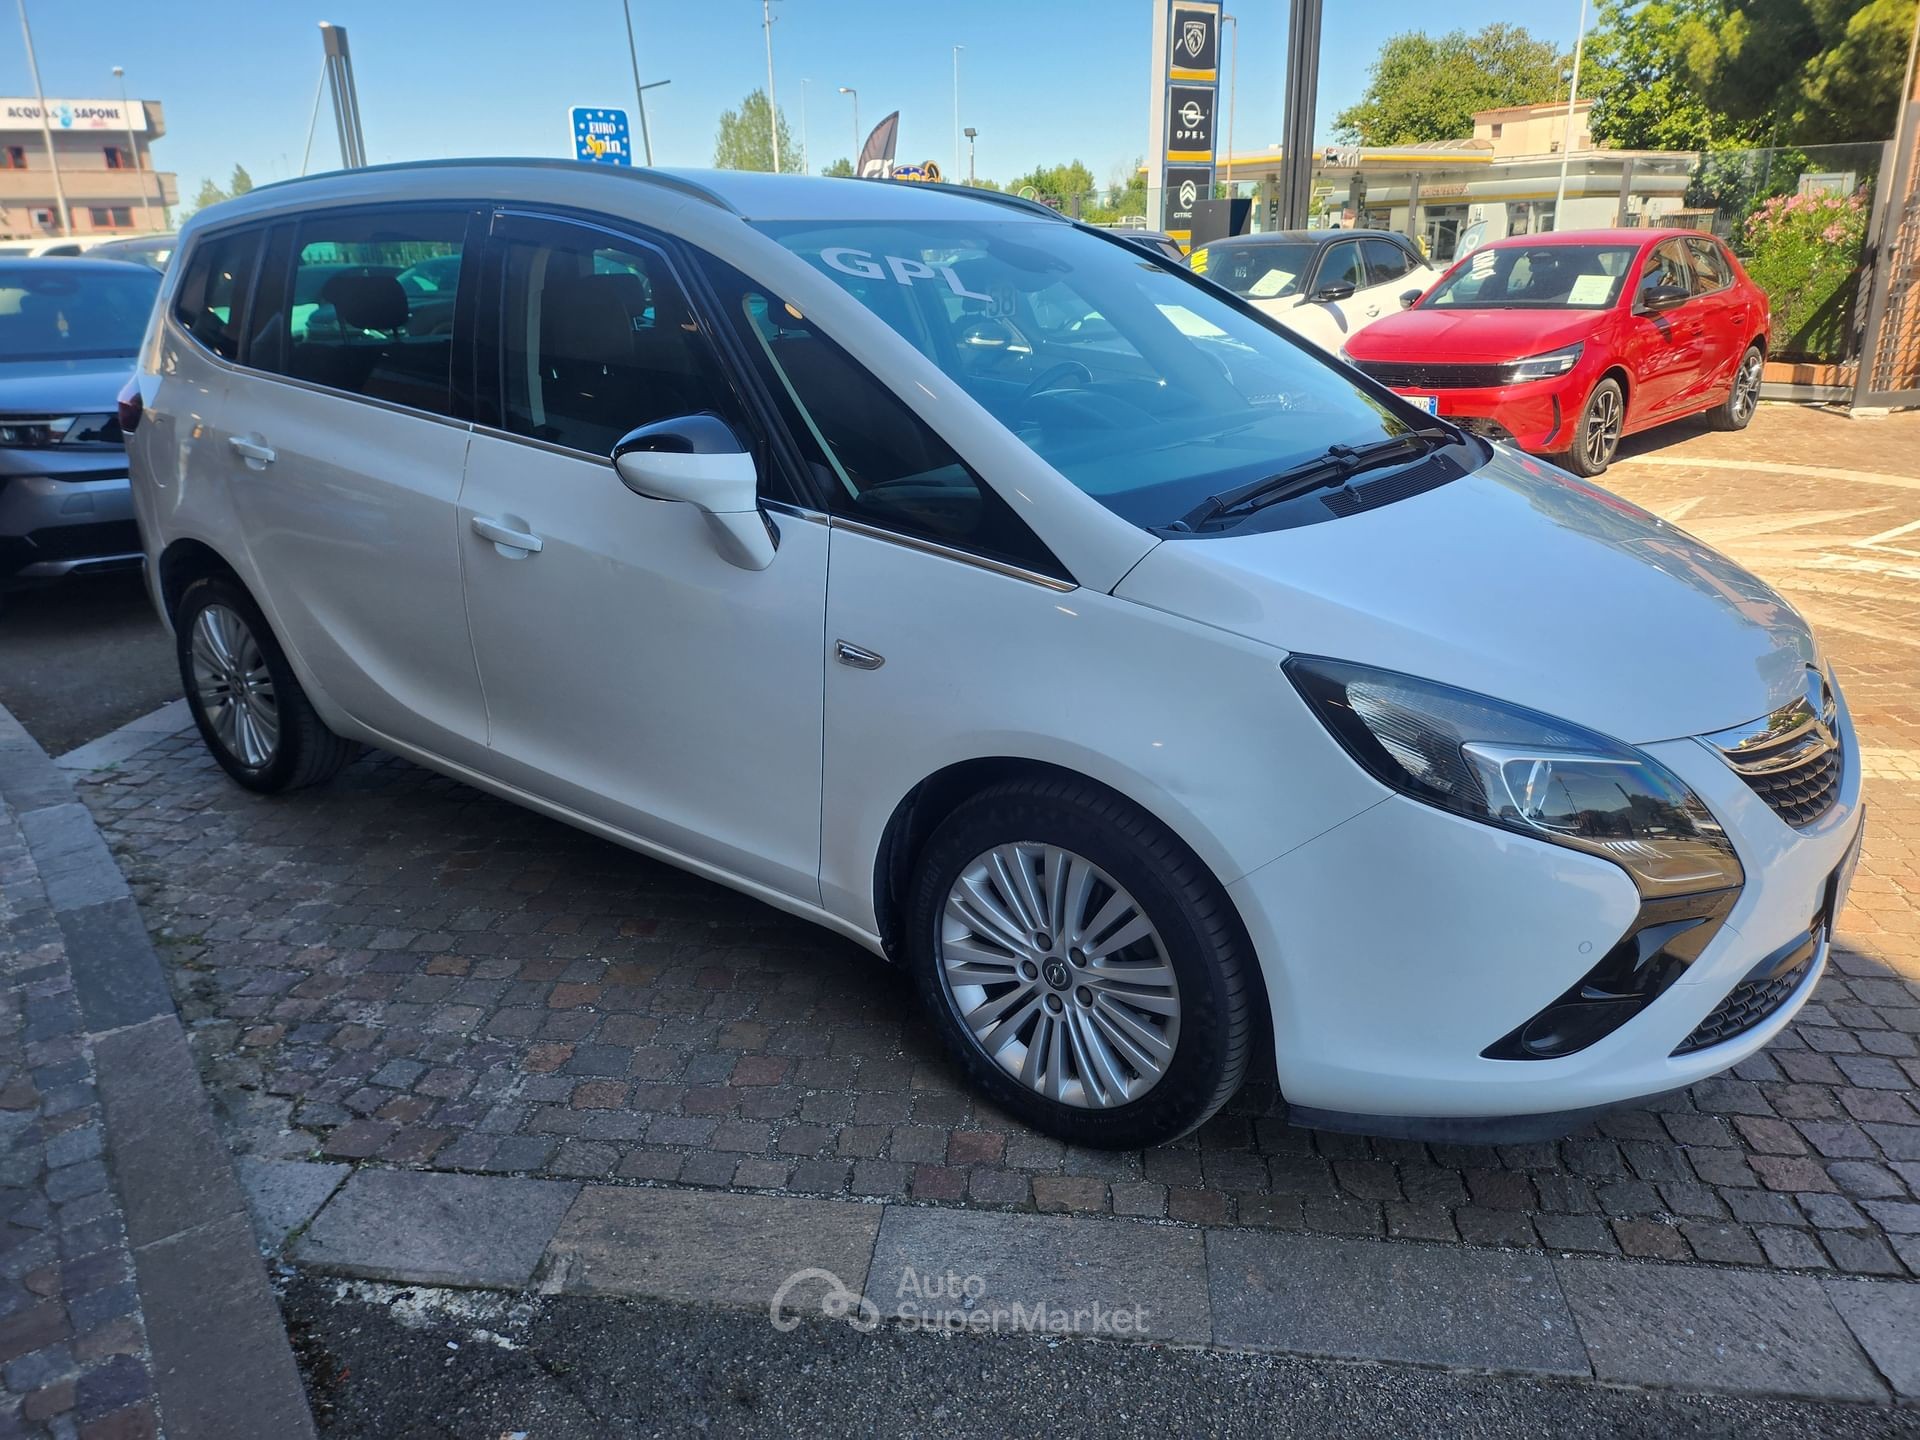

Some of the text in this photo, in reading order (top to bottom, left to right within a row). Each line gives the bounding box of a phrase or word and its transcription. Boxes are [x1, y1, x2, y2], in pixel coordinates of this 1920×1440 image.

[74, 108, 121, 119] SAPONE
[588, 121, 616, 134] EURO
[1176, 130, 1206, 140] OPEL
[585, 134, 622, 158] Spin
[1338, 145, 1360, 168] eni
[820, 247, 993, 303] GPL
